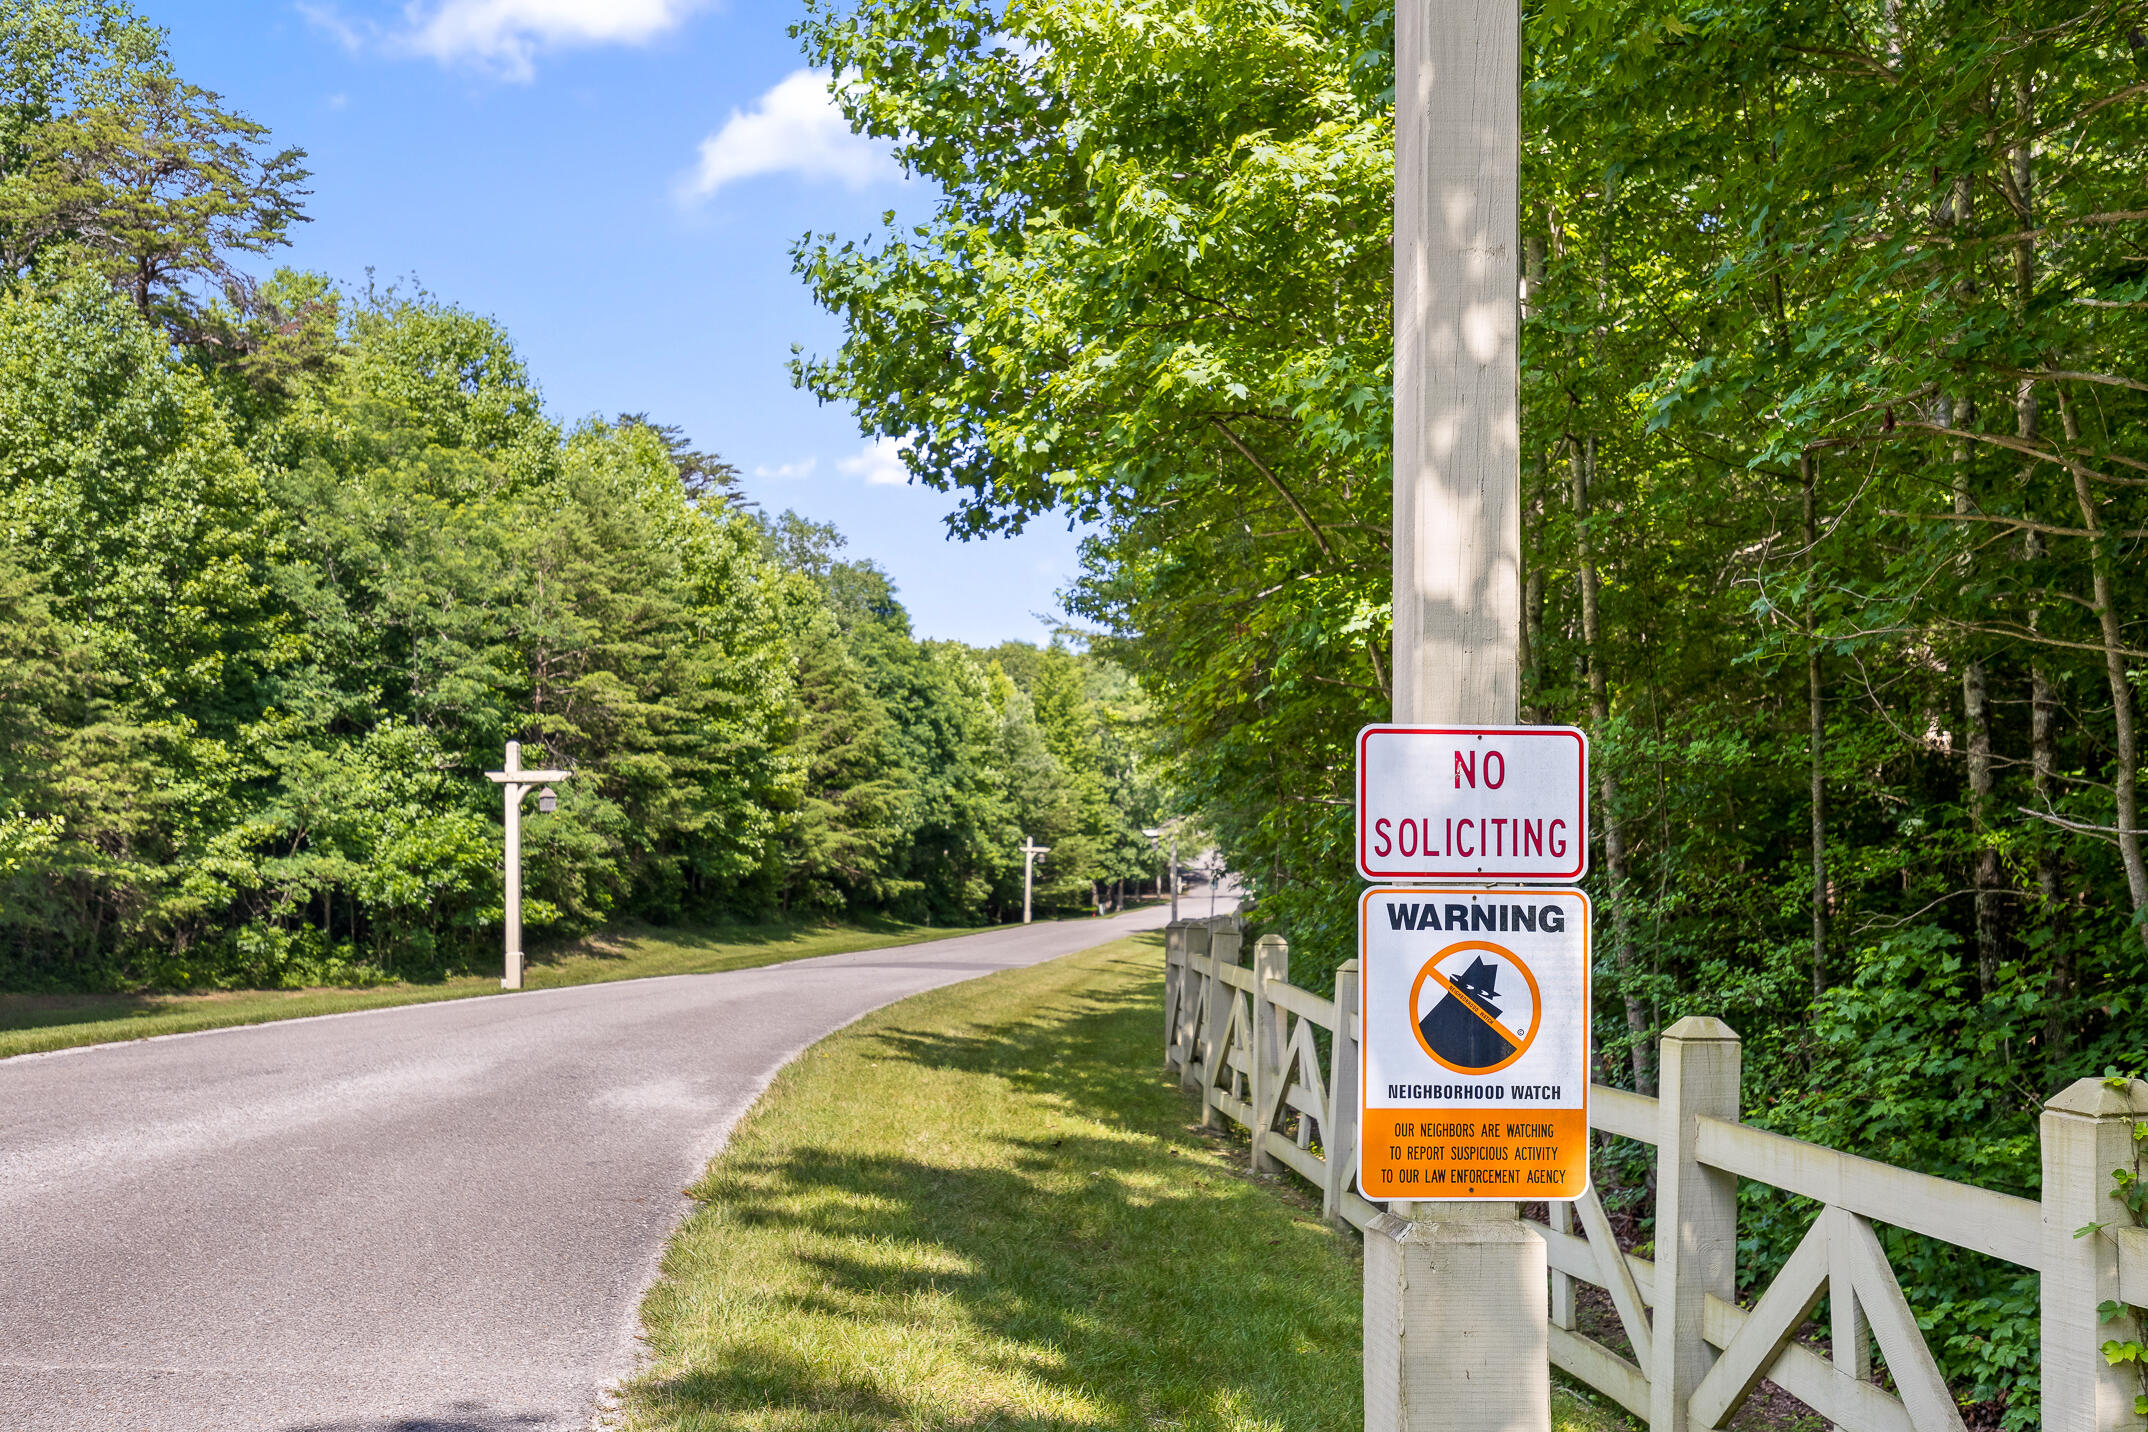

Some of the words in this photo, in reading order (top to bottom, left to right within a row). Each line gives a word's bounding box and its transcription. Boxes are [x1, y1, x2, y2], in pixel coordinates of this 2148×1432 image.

[1454, 750, 1505, 789] NO
[1374, 818, 1567, 857] SOLICITING
[1386, 903, 1565, 932] WARNING
[1479, 1011, 1494, 1025] WATCH
[1388, 1084, 1504, 1099] NEIGHBORHOOD
[1511, 1085, 1561, 1100] WATCH
[1394, 1123, 1414, 1137] OUR
[1420, 1123, 1475, 1138] NEIGHBORS
[1481, 1123, 1500, 1137] ARE
[1507, 1124, 1554, 1138] WATCHING
[1390, 1146, 1401, 1160] TO
[1407, 1146, 1445, 1160] REPORT
[1451, 1146, 1508, 1161] SUSPICIOUS
[1514, 1147, 1558, 1161] ACTIVITY
[1381, 1169, 1393, 1183] TO
[1399, 1169, 1419, 1183] OUR
[1425, 1169, 1445, 1183] LAW
[1451, 1169, 1520, 1183] ENFORCEMENT
[1527, 1169, 1566, 1184] AGENCY
